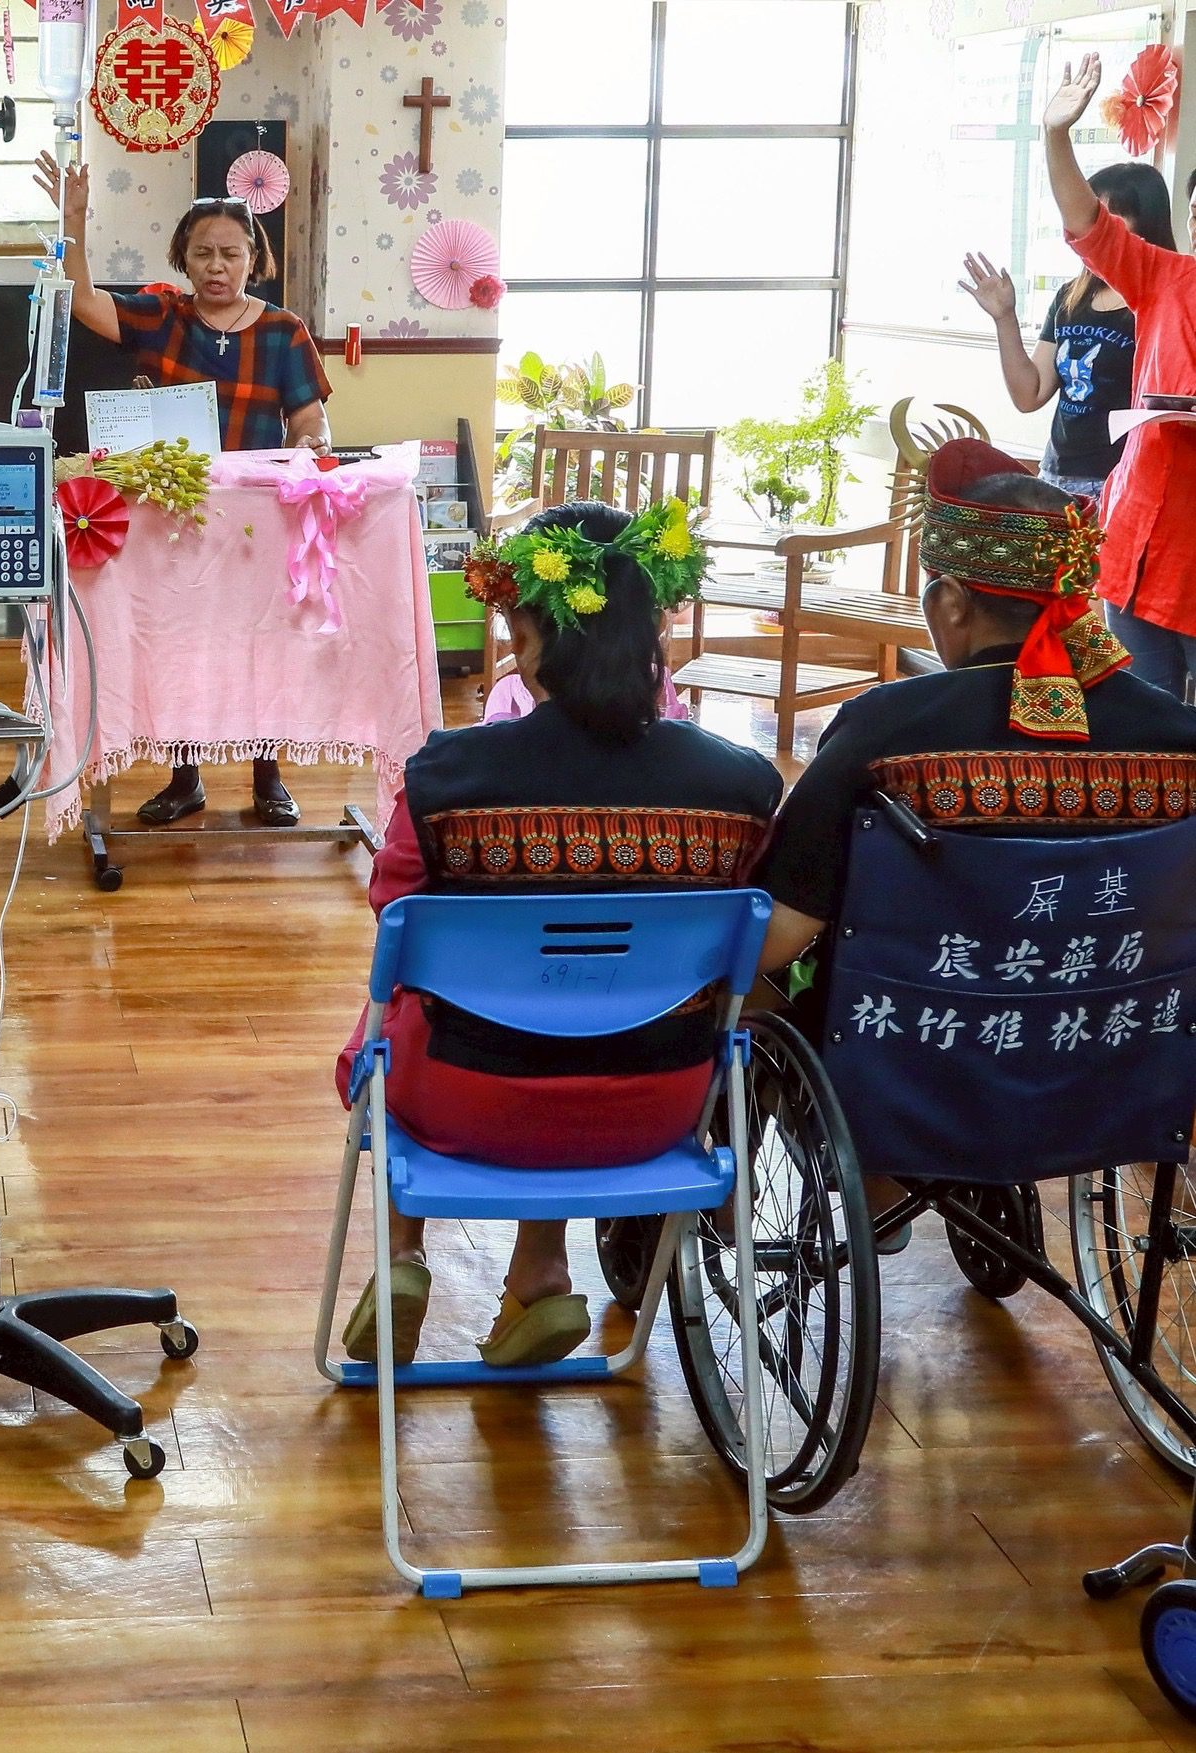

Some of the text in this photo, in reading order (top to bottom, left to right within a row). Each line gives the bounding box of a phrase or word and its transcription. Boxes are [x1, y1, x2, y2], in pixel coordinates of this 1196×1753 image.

[1013, 867, 1135, 921] 屏基
[849, 994, 1024, 1055] 林竹雄
